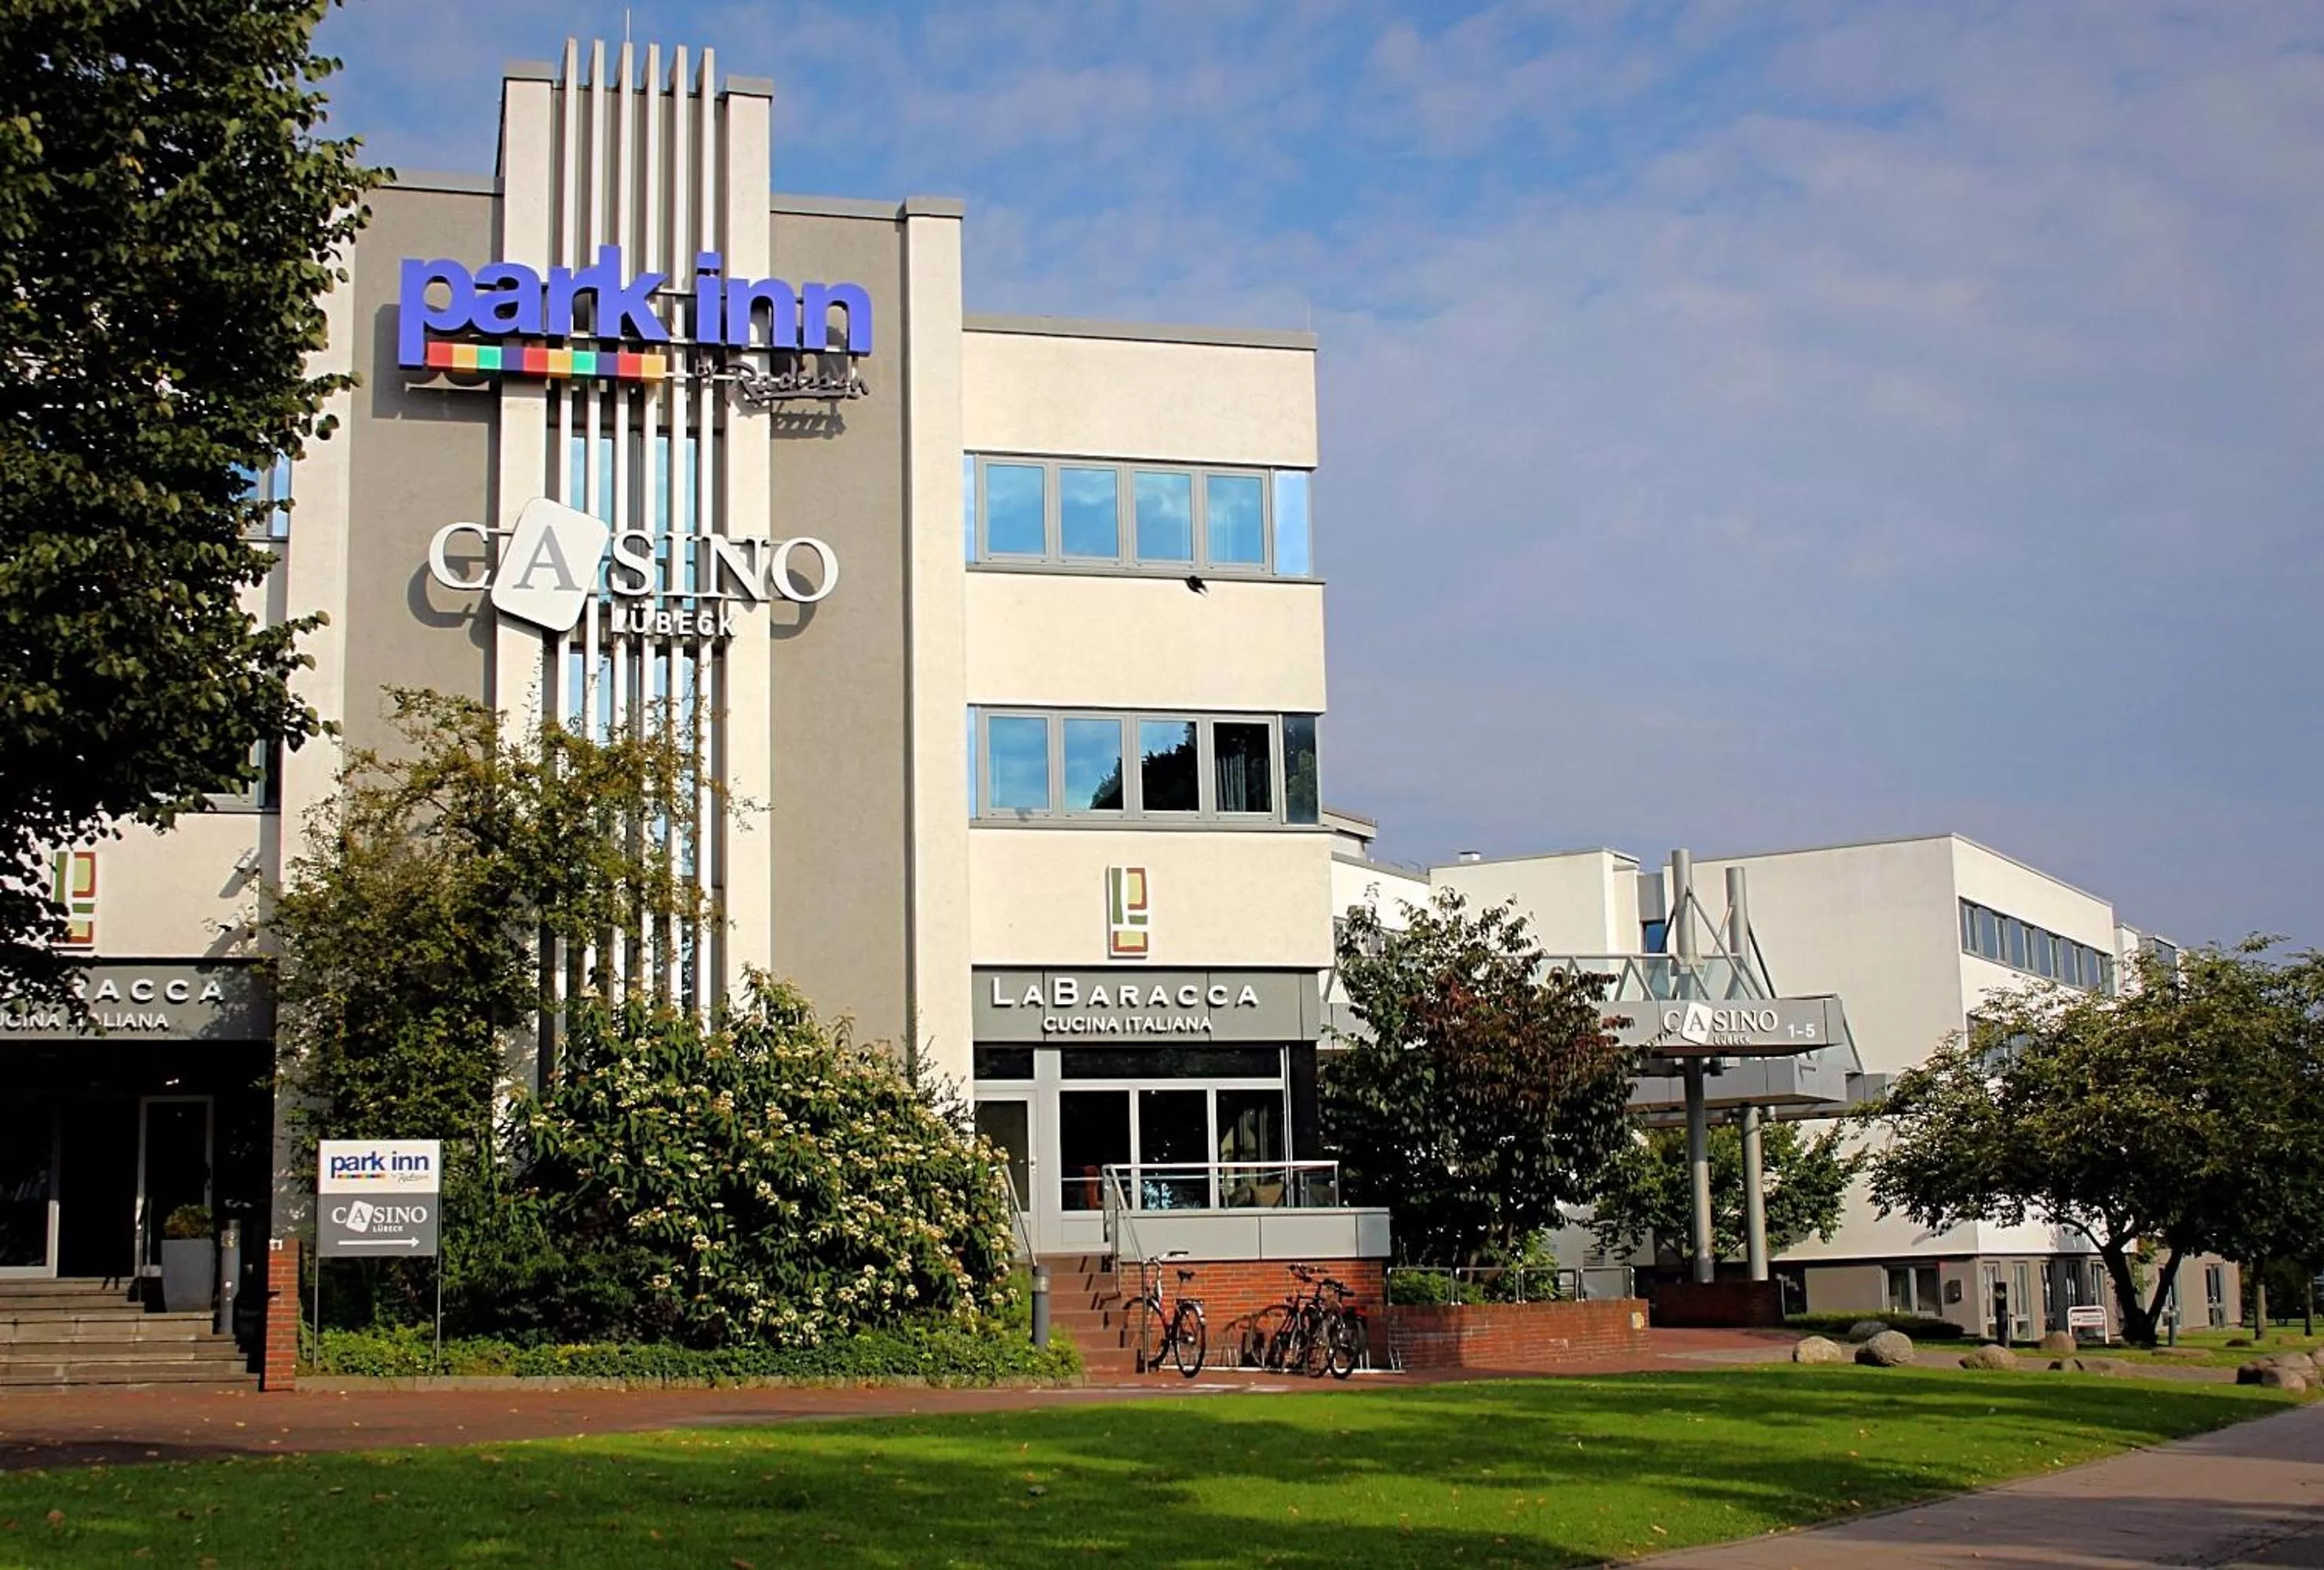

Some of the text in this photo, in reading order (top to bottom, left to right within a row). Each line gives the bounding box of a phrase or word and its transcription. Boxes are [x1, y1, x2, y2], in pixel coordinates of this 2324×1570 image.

[399, 244, 873, 370] park inn
[429, 521, 839, 603] CASINO
[1044, 1014, 1212, 1032] CUCINA ITALIANA
[1663, 1010, 1815, 1039] CASINO 1-5
[330, 1151, 385, 1178] park
[392, 1151, 429, 1170] inn
[331, 1206, 428, 1224] CASINO
